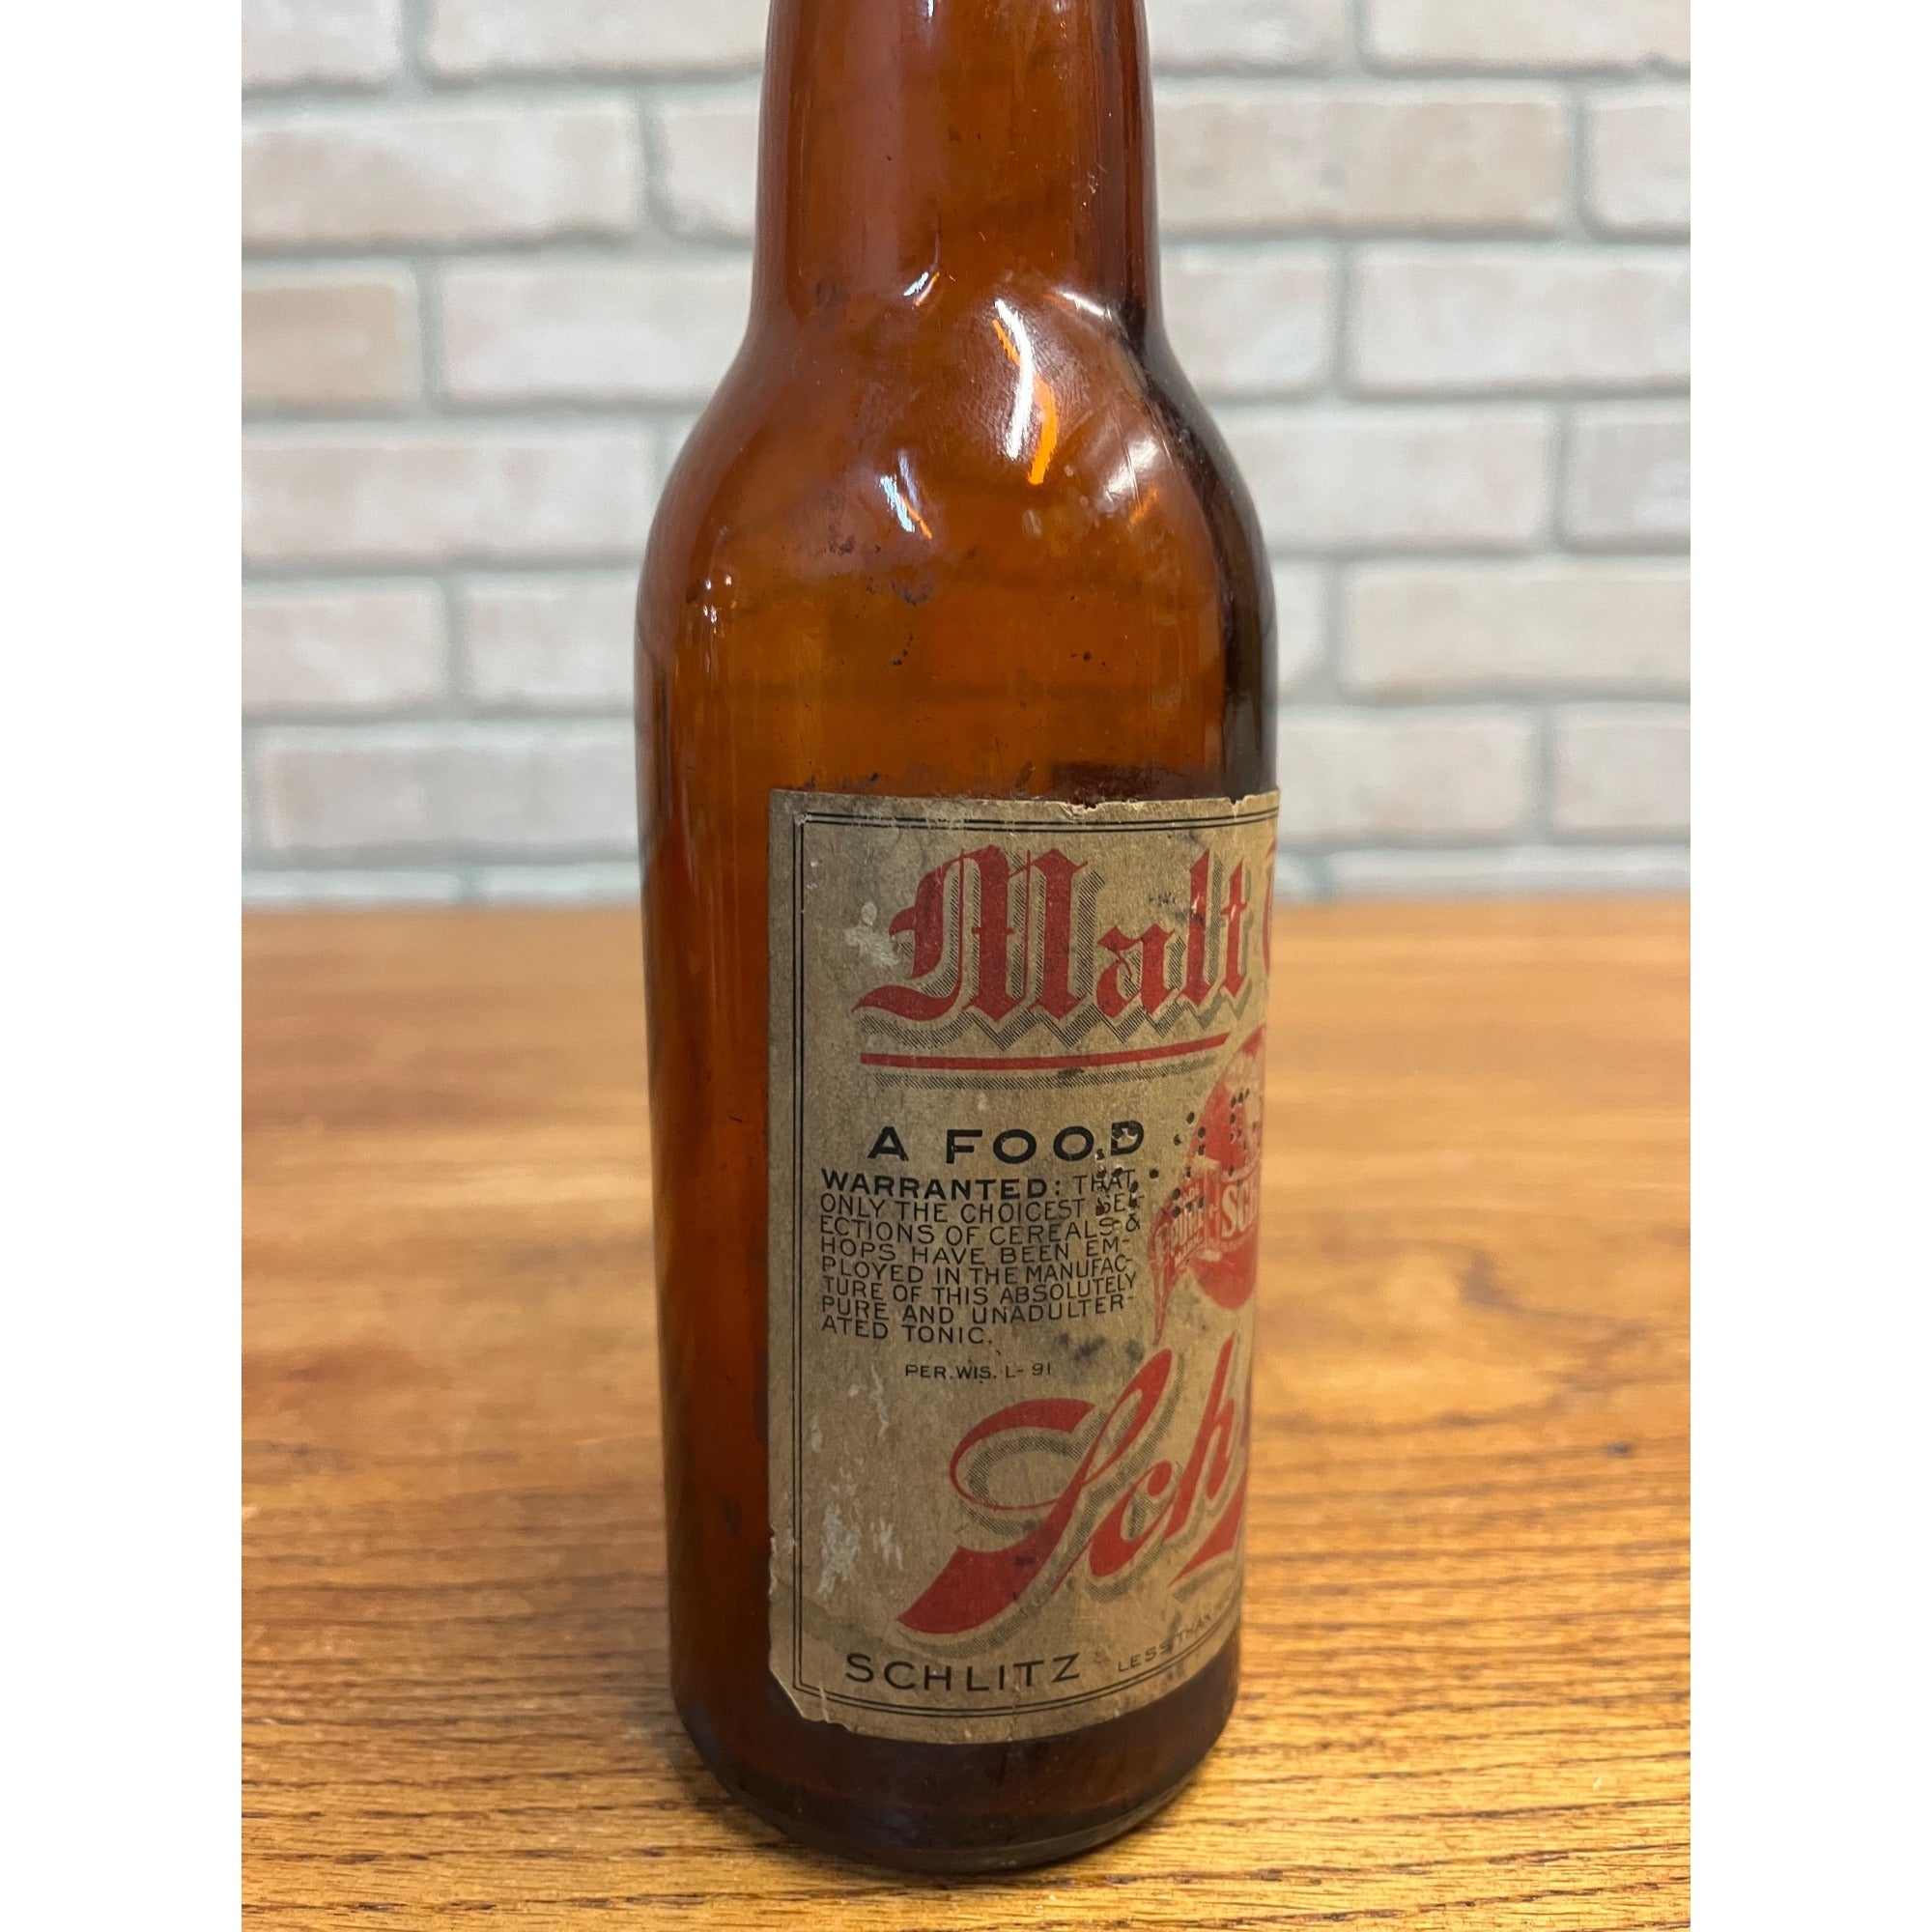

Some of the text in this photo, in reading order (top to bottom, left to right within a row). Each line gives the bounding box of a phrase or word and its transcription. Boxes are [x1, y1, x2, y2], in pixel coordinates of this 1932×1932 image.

[851, 843, 1249, 1022] Malt
[868, 1121, 1145, 1164] A FOOD
[821, 1168, 1060, 1201] WARRANTED:
[821, 1193, 885, 1218] ONLY
[895, 1201, 948, 1222] THE
[961, 1198, 1085, 1223] CHOICEST
[821, 1213, 1140, 1246] ECTIONS OF CEREALS &
[821, 1236, 1130, 1264] HOPS HAVE BEEN EM-
[822, 1254, 1132, 1285] PLOYED IN THE MANUFAC-
[823, 1271, 1136, 1305] TURE OF THIS ABSOLUTELY
[822, 1294, 1133, 1324] PURE AND UNADULTER-
[821, 1315, 992, 1344] ATED TONIC.
[896, 1331, 1248, 1634] Sch
[845, 1652, 1082, 1692] SCHLITZ
[1118, 1642, 1173, 1672] LESS
